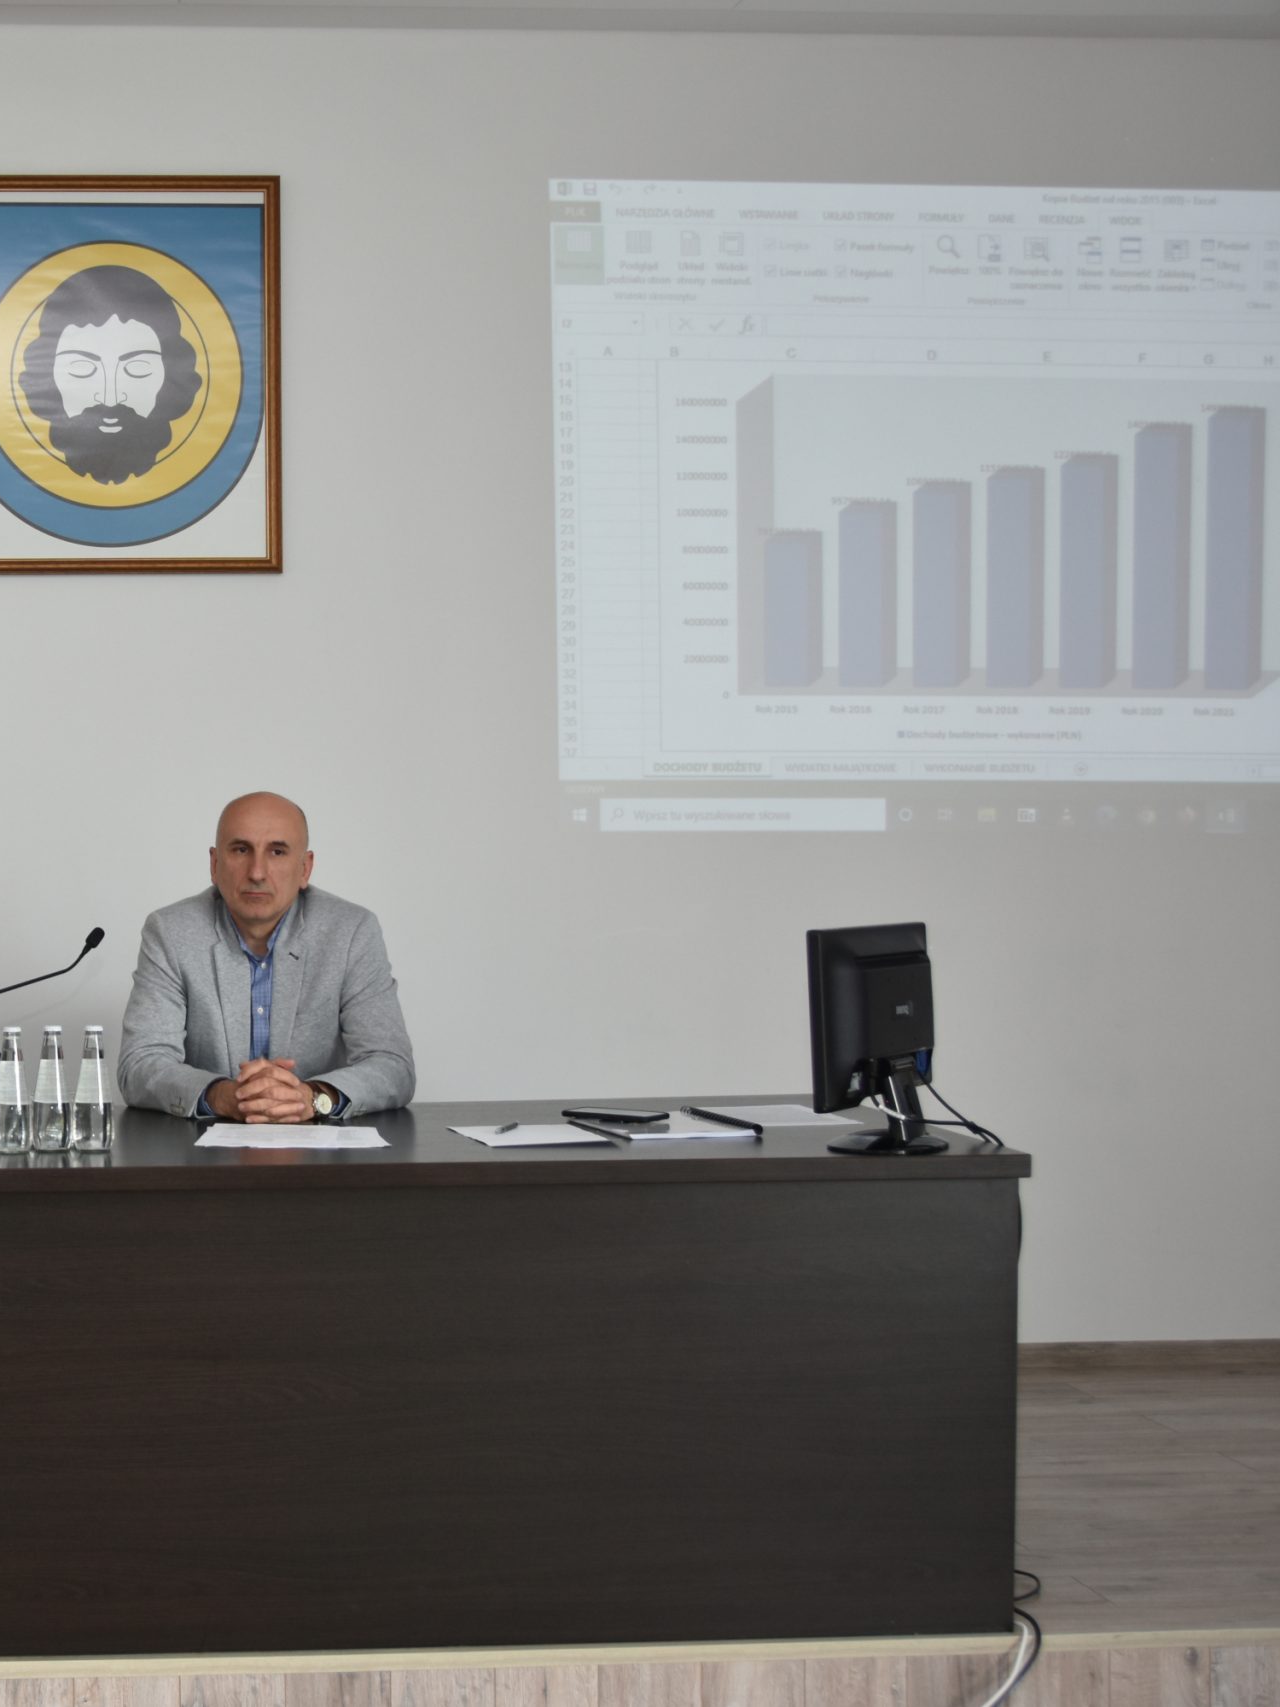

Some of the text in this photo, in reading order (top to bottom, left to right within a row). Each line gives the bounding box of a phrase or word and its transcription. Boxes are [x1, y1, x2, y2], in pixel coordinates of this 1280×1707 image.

[615, 205, 715, 220] NARZĘDZIA GŁÓWNE
[738, 209, 798, 220] WSTAWIANIE
[822, 210, 895, 222] UKŁAD STRONY
[918, 212, 965, 223] FORMUŁY
[988, 213, 1016, 224] DANE
[603, 346, 613, 356] A
[670, 346, 680, 357] B
[786, 347, 797, 358] C
[927, 350, 937, 360] D
[1042, 352, 1052, 362] E
[1138, 352, 1147, 362] F
[1203, 354, 1215, 365] G
[1263, 355, 1273, 365] H
[559, 362, 572, 372] 13
[559, 379, 572, 388] 14
[559, 395, 573, 405] 15
[559, 411, 573, 421] 16
[560, 427, 573, 437] 17
[560, 444, 573, 454] 18
[560, 460, 574, 470] 19
[560, 476, 574, 487] 20
[560, 492, 573, 502] 21
[560, 508, 575, 519] 22
[560, 525, 575, 535] 23
[560, 541, 575, 551] 24
[561, 557, 576, 567] 25
[561, 573, 575, 583] 26
[561, 589, 576, 599] 27
[561, 605, 576, 615] 28
[562, 621, 576, 631] 29
[561, 637, 576, 647] 30
[562, 653, 575, 663] 31
[562, 669, 577, 679] 32
[562, 685, 577, 695] 33
[562, 701, 577, 711] 34
[755, 705, 772, 714] Rok
[830, 705, 846, 713] Rok
[903, 705, 945, 714] Rok 2017
[976, 706, 993, 714] Rok
[1049, 706, 1065, 715] Rok
[562, 716, 577, 727] 35
[563, 733, 577, 743] 36
[907, 731, 946, 740] Dochody
[653, 760, 762, 772] DOCHODY BUDŻETU
[785, 763, 830, 772] WYDATKI
[924, 763, 986, 772] WYKONANIE
[634, 810, 667, 823] Wpisz
[670, 811, 681, 821] tu
[684, 811, 755, 823] wyszukiwane
